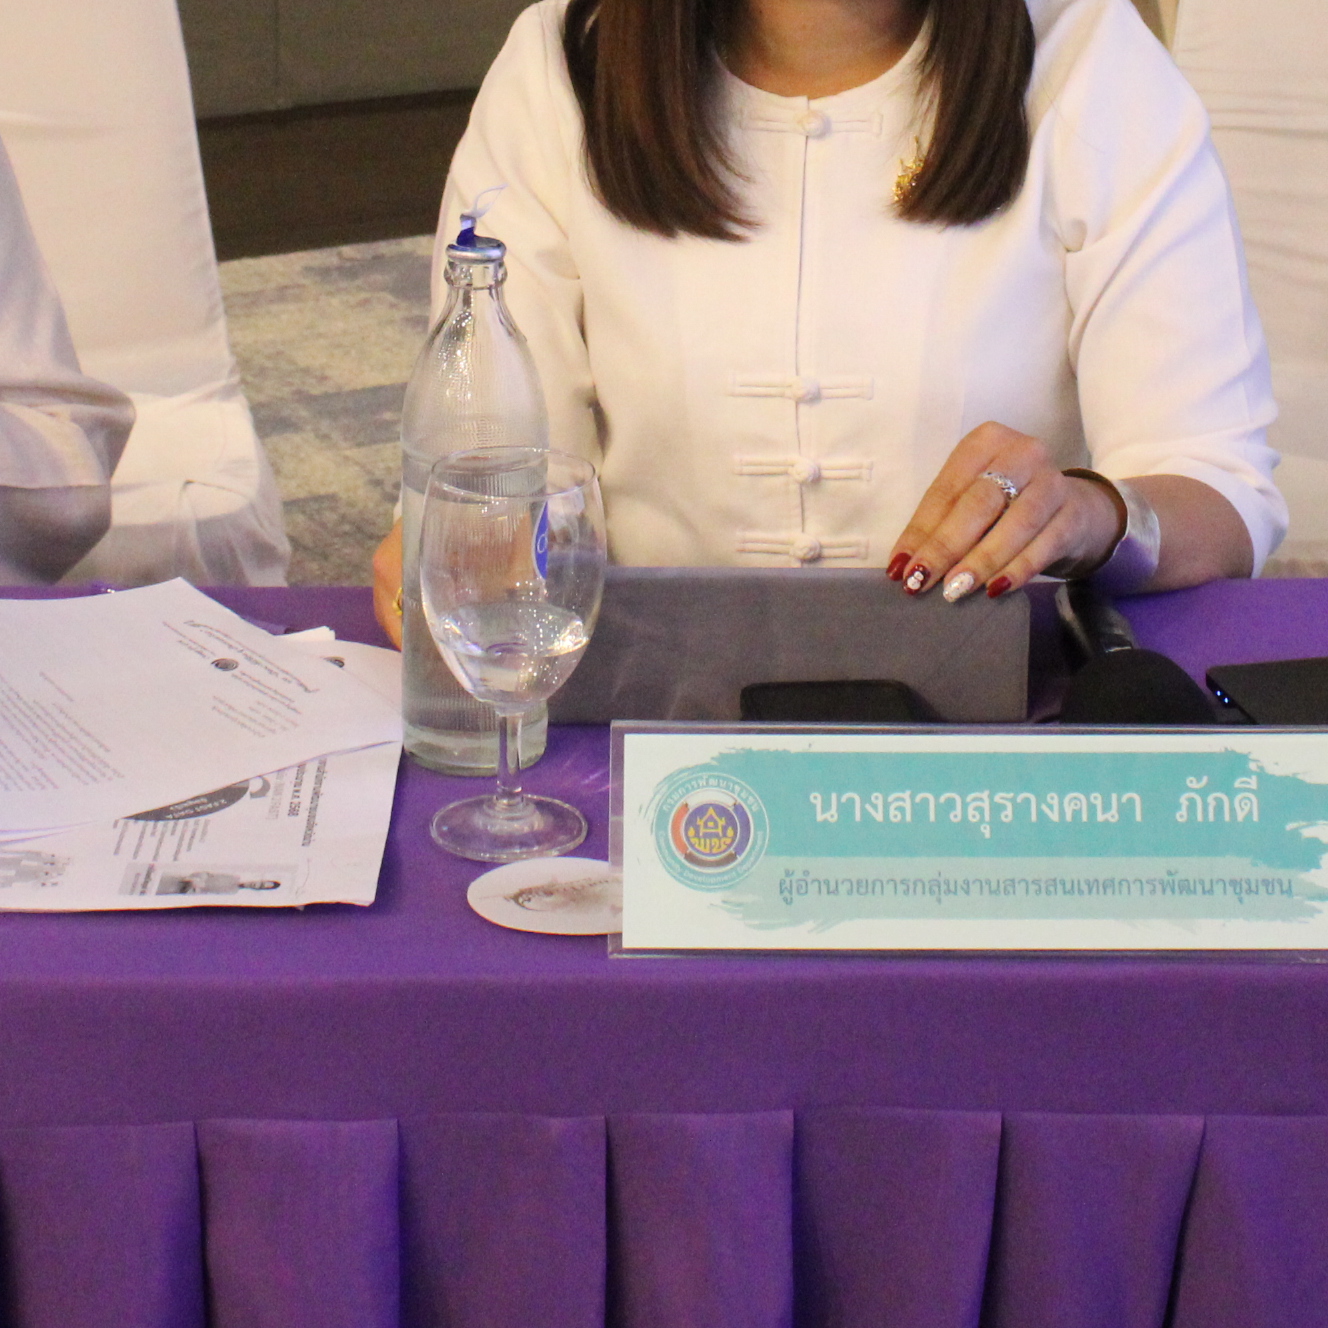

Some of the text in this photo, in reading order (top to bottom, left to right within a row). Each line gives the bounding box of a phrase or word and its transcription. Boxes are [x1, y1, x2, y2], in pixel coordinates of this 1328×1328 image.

[809, 775, 1260, 839] นางสาวสุรางคนา ภักดี
[778, 868, 1294, 906] ผู้อำนวยการกลุ่มงานสารสนเทศการพัฒนาชุมชน
